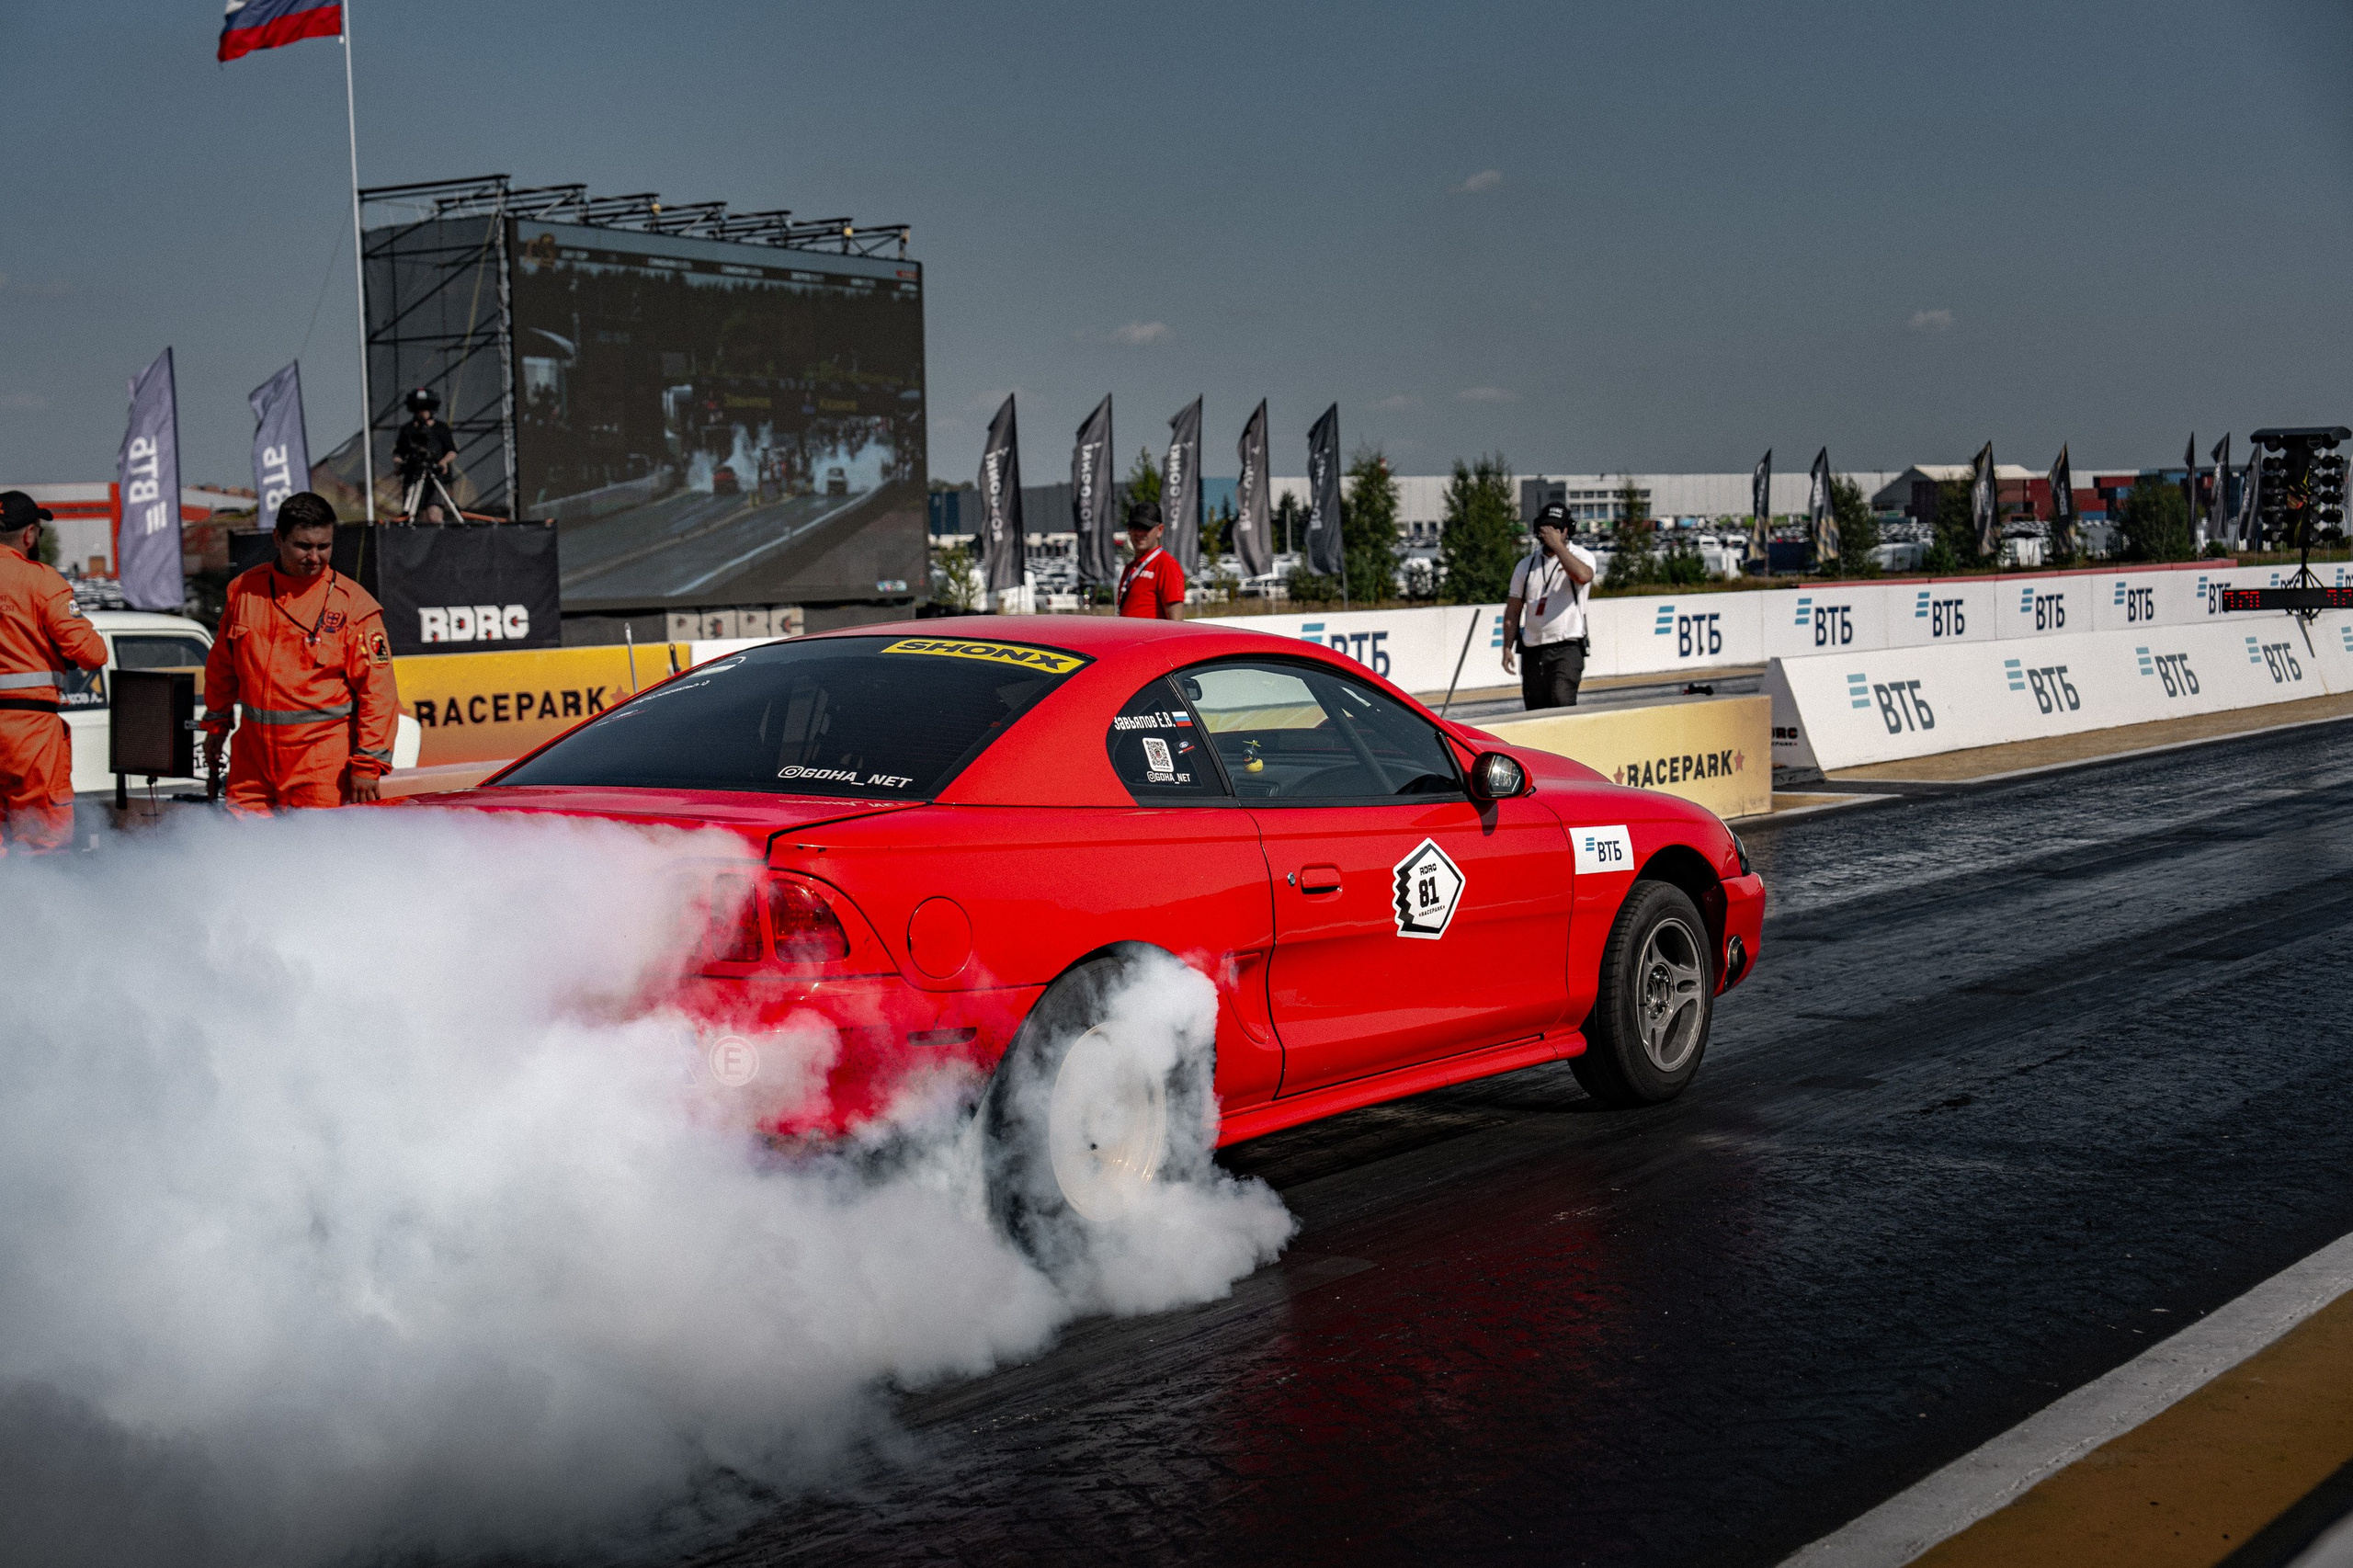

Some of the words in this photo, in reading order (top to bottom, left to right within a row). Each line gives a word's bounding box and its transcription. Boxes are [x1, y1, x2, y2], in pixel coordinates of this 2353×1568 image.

[2035, 594, 2065, 631] ВТБ
[2127, 587, 2154, 622] ВТБ
[2209, 583, 2231, 614] ВТ
[418, 604, 529, 642] RDRC
[1678, 613, 1722, 657] ВТБ
[1815, 606, 1852, 646] ВТБ
[1932, 599, 1964, 637] ВТБ
[897, 641, 1069, 670] SHONX
[2262, 642, 2302, 683] ВТБ
[2027, 665, 2081, 714] ВТБ
[2154, 653, 2200, 698] ВТБ
[415, 686, 607, 728] RACEPARK
[1873, 679, 1935, 734] ВТБ
[1627, 749, 1733, 788] RACEPARK
[1419, 863, 1437, 876] RDRC
[1597, 840, 1622, 862] ВТБ
[1418, 876, 1439, 908] 81
